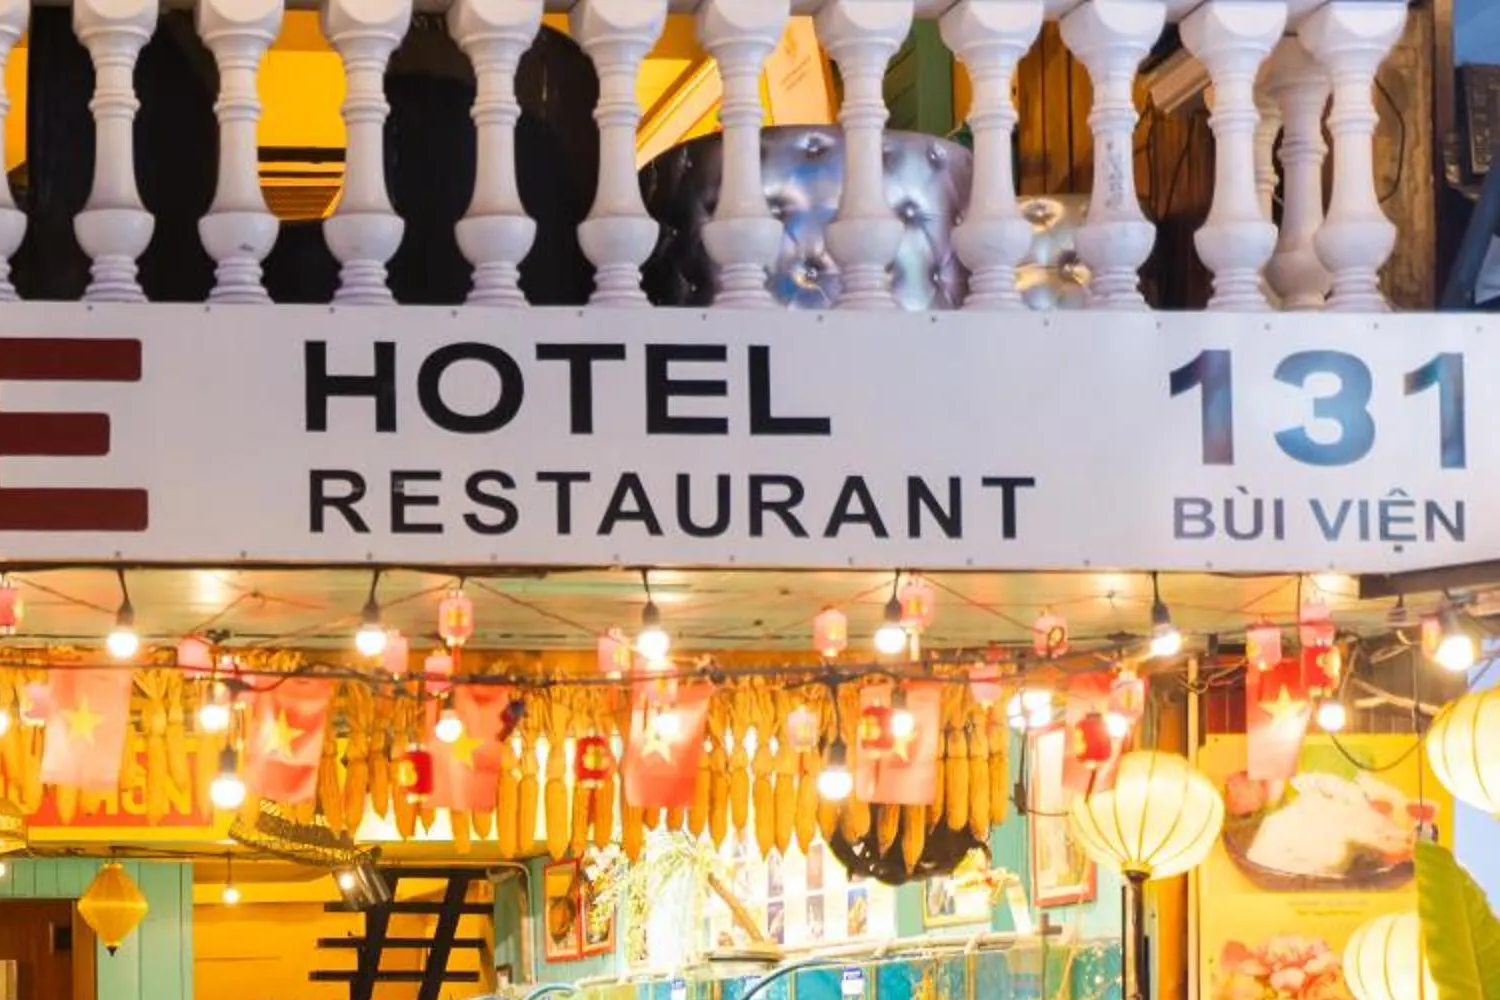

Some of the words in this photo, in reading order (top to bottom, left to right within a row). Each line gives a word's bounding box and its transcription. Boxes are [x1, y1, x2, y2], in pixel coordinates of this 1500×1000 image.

[304, 340, 832, 437] HOTEL
[1169, 348, 1467, 469] 131
[308, 469, 1036, 540] RESTAURANT
[1172, 484, 1285, 541] BÙI
[1308, 487, 1466, 553] VIỆN
